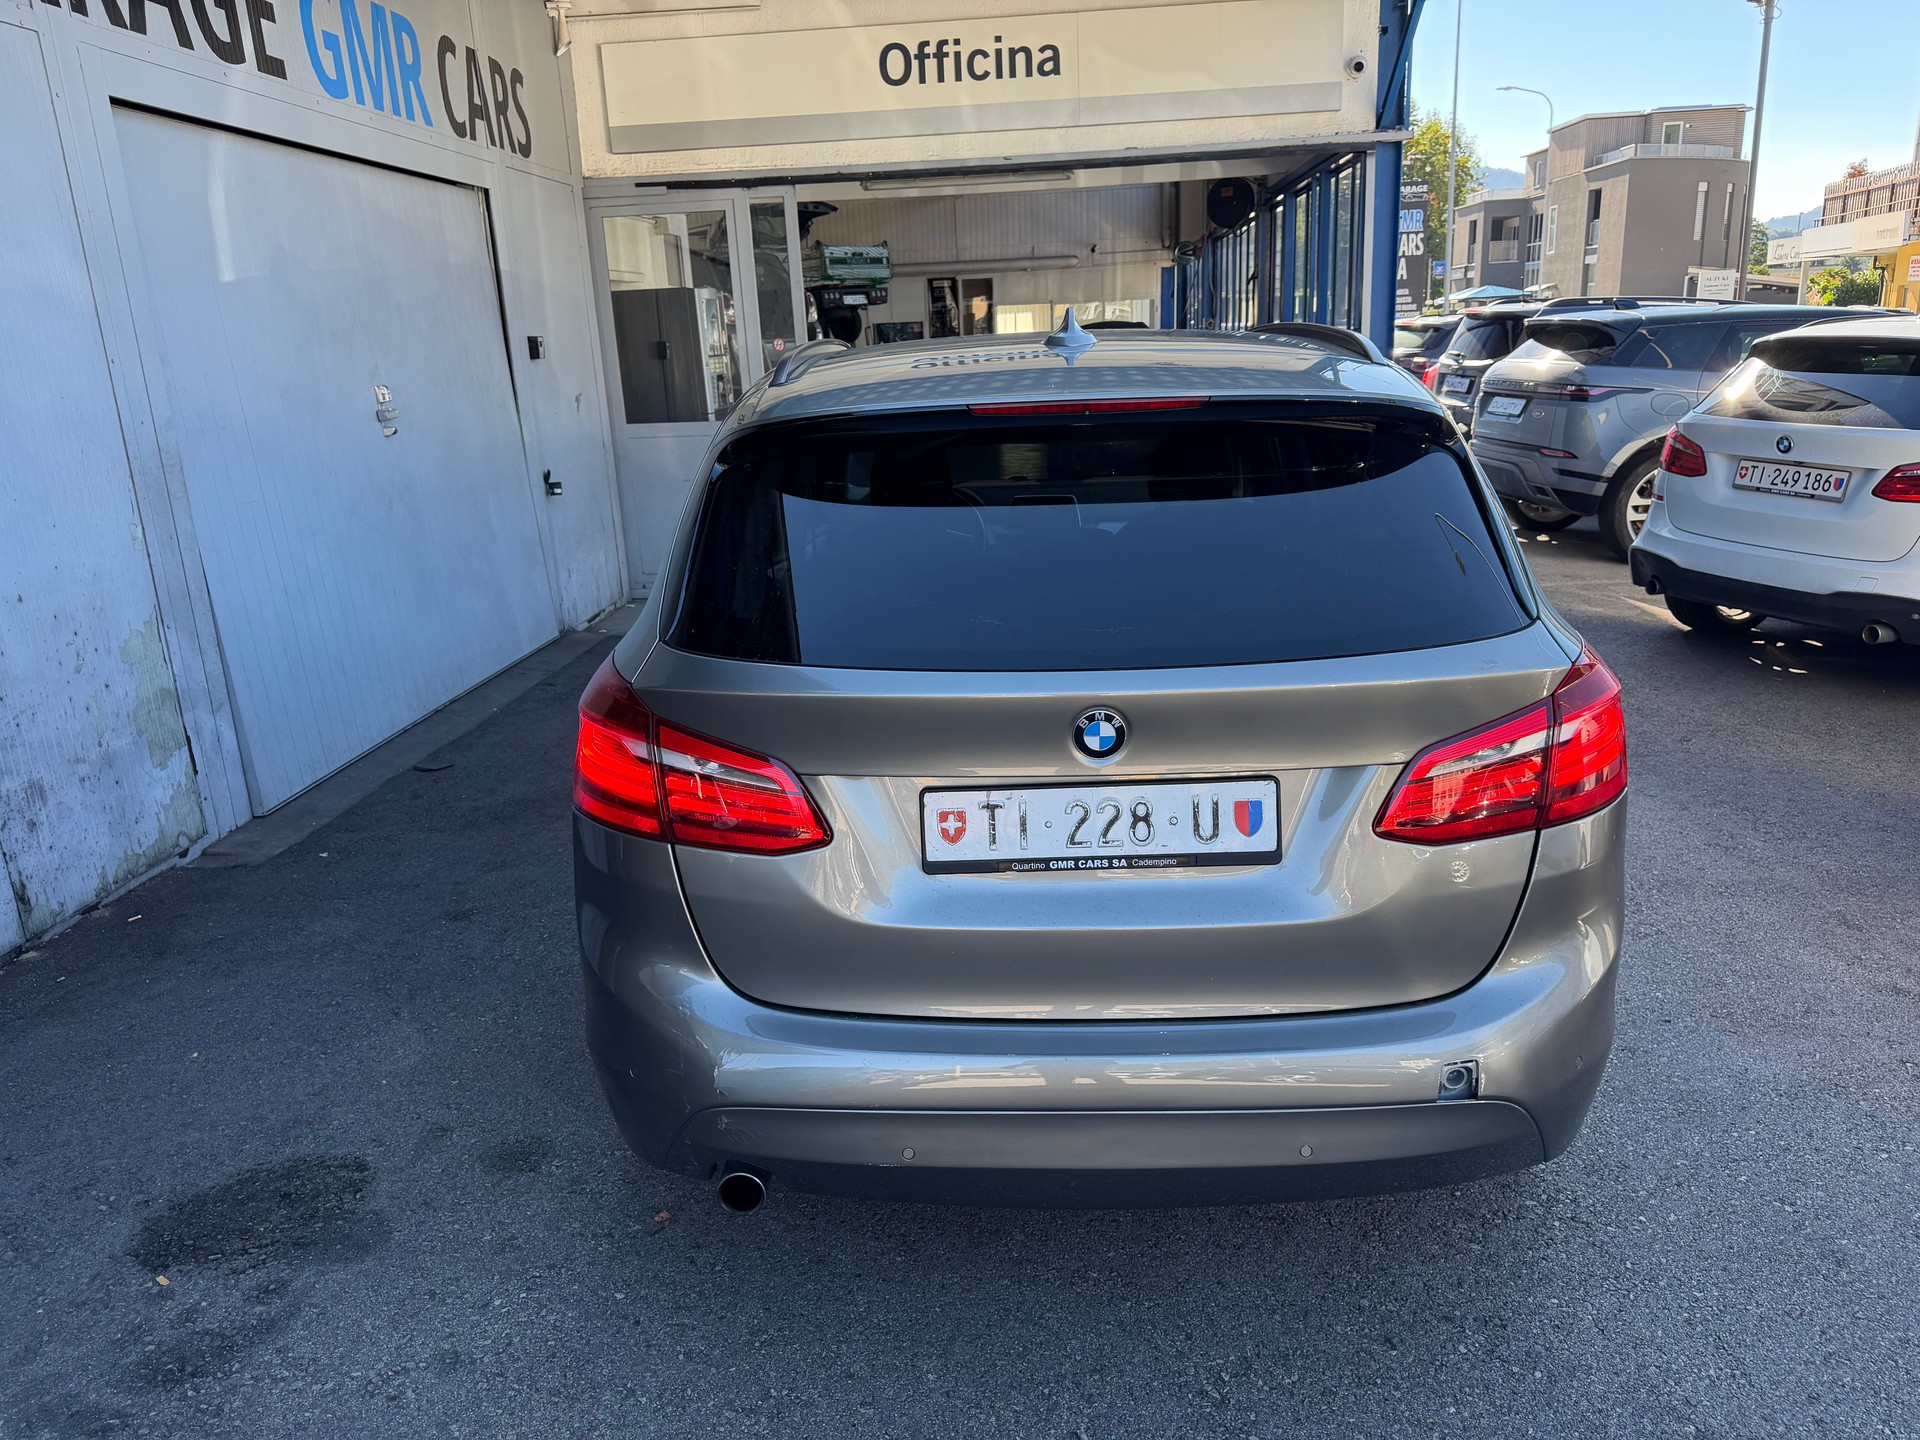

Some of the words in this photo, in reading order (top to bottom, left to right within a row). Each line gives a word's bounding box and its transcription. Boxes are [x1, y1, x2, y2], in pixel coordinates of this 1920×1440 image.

[879, 35, 1061, 87] Officina
[298, 0, 434, 128] GMR
[437, 34, 532, 159] CARS
[1401, 184, 1428, 193] ARAGE
[1398, 232, 1424, 256] ARS
[1078, 712, 1122, 729] BMW
[1011, 862, 1046, 871] Quartino
[1050, 860, 1075, 869] GMR
[1078, 859, 1109, 868] CARS
[1112, 859, 1128, 867] SA
[1132, 857, 1177, 867] Cadempino
